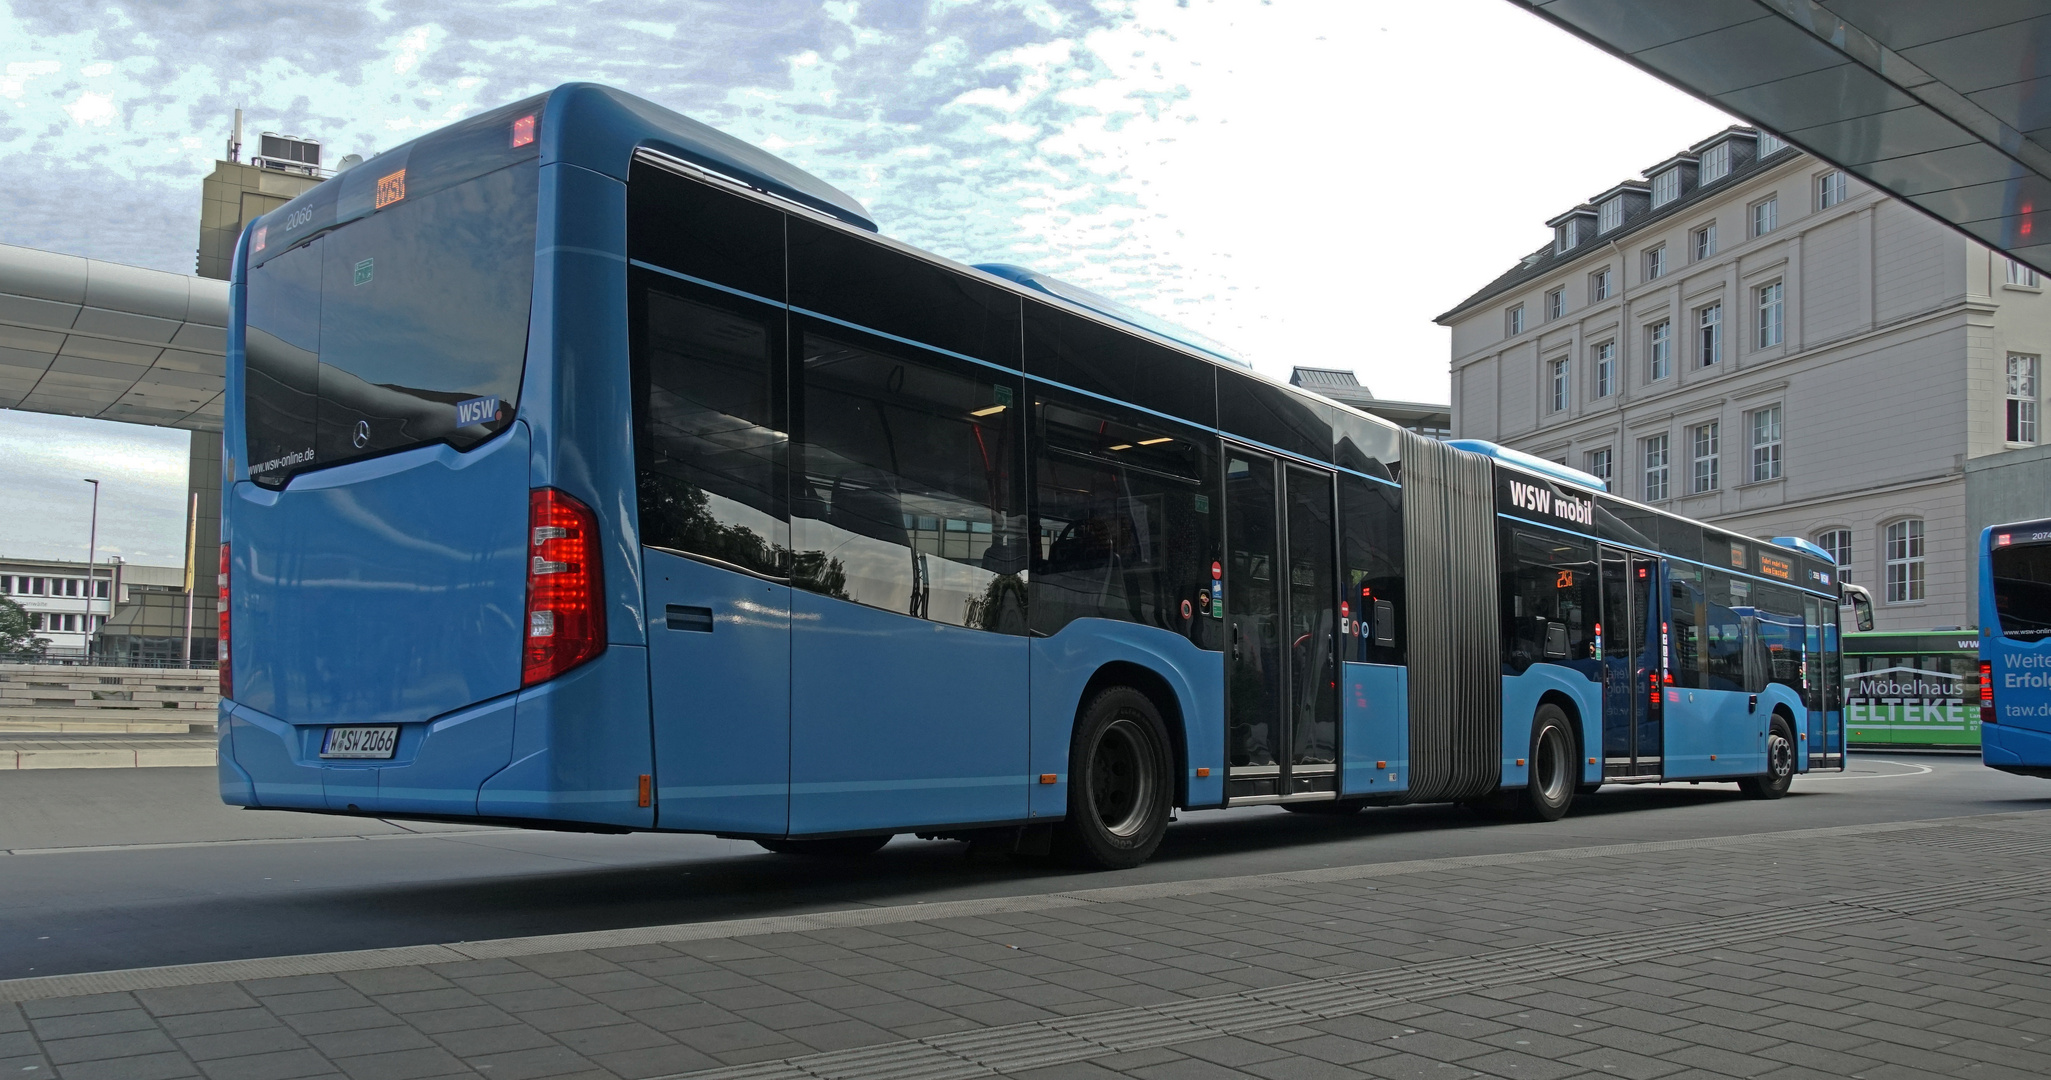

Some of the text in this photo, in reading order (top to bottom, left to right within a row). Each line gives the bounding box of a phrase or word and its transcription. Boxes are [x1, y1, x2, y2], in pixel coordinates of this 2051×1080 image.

[286, 204, 313, 231] 2066
[460, 399, 494, 423] WSW
[248, 447, 315, 476] www.wsw-online.de
[1510, 480, 1592, 525] WSW mobil
[2004, 653, 2051, 668] Weite
[1860, 680, 1963, 695] Möbelhaus
[1844, 688, 1964, 722] ELTEKE
[2005, 703, 2051, 717] taw.d
[330, 730, 394, 751] W SW 2066
